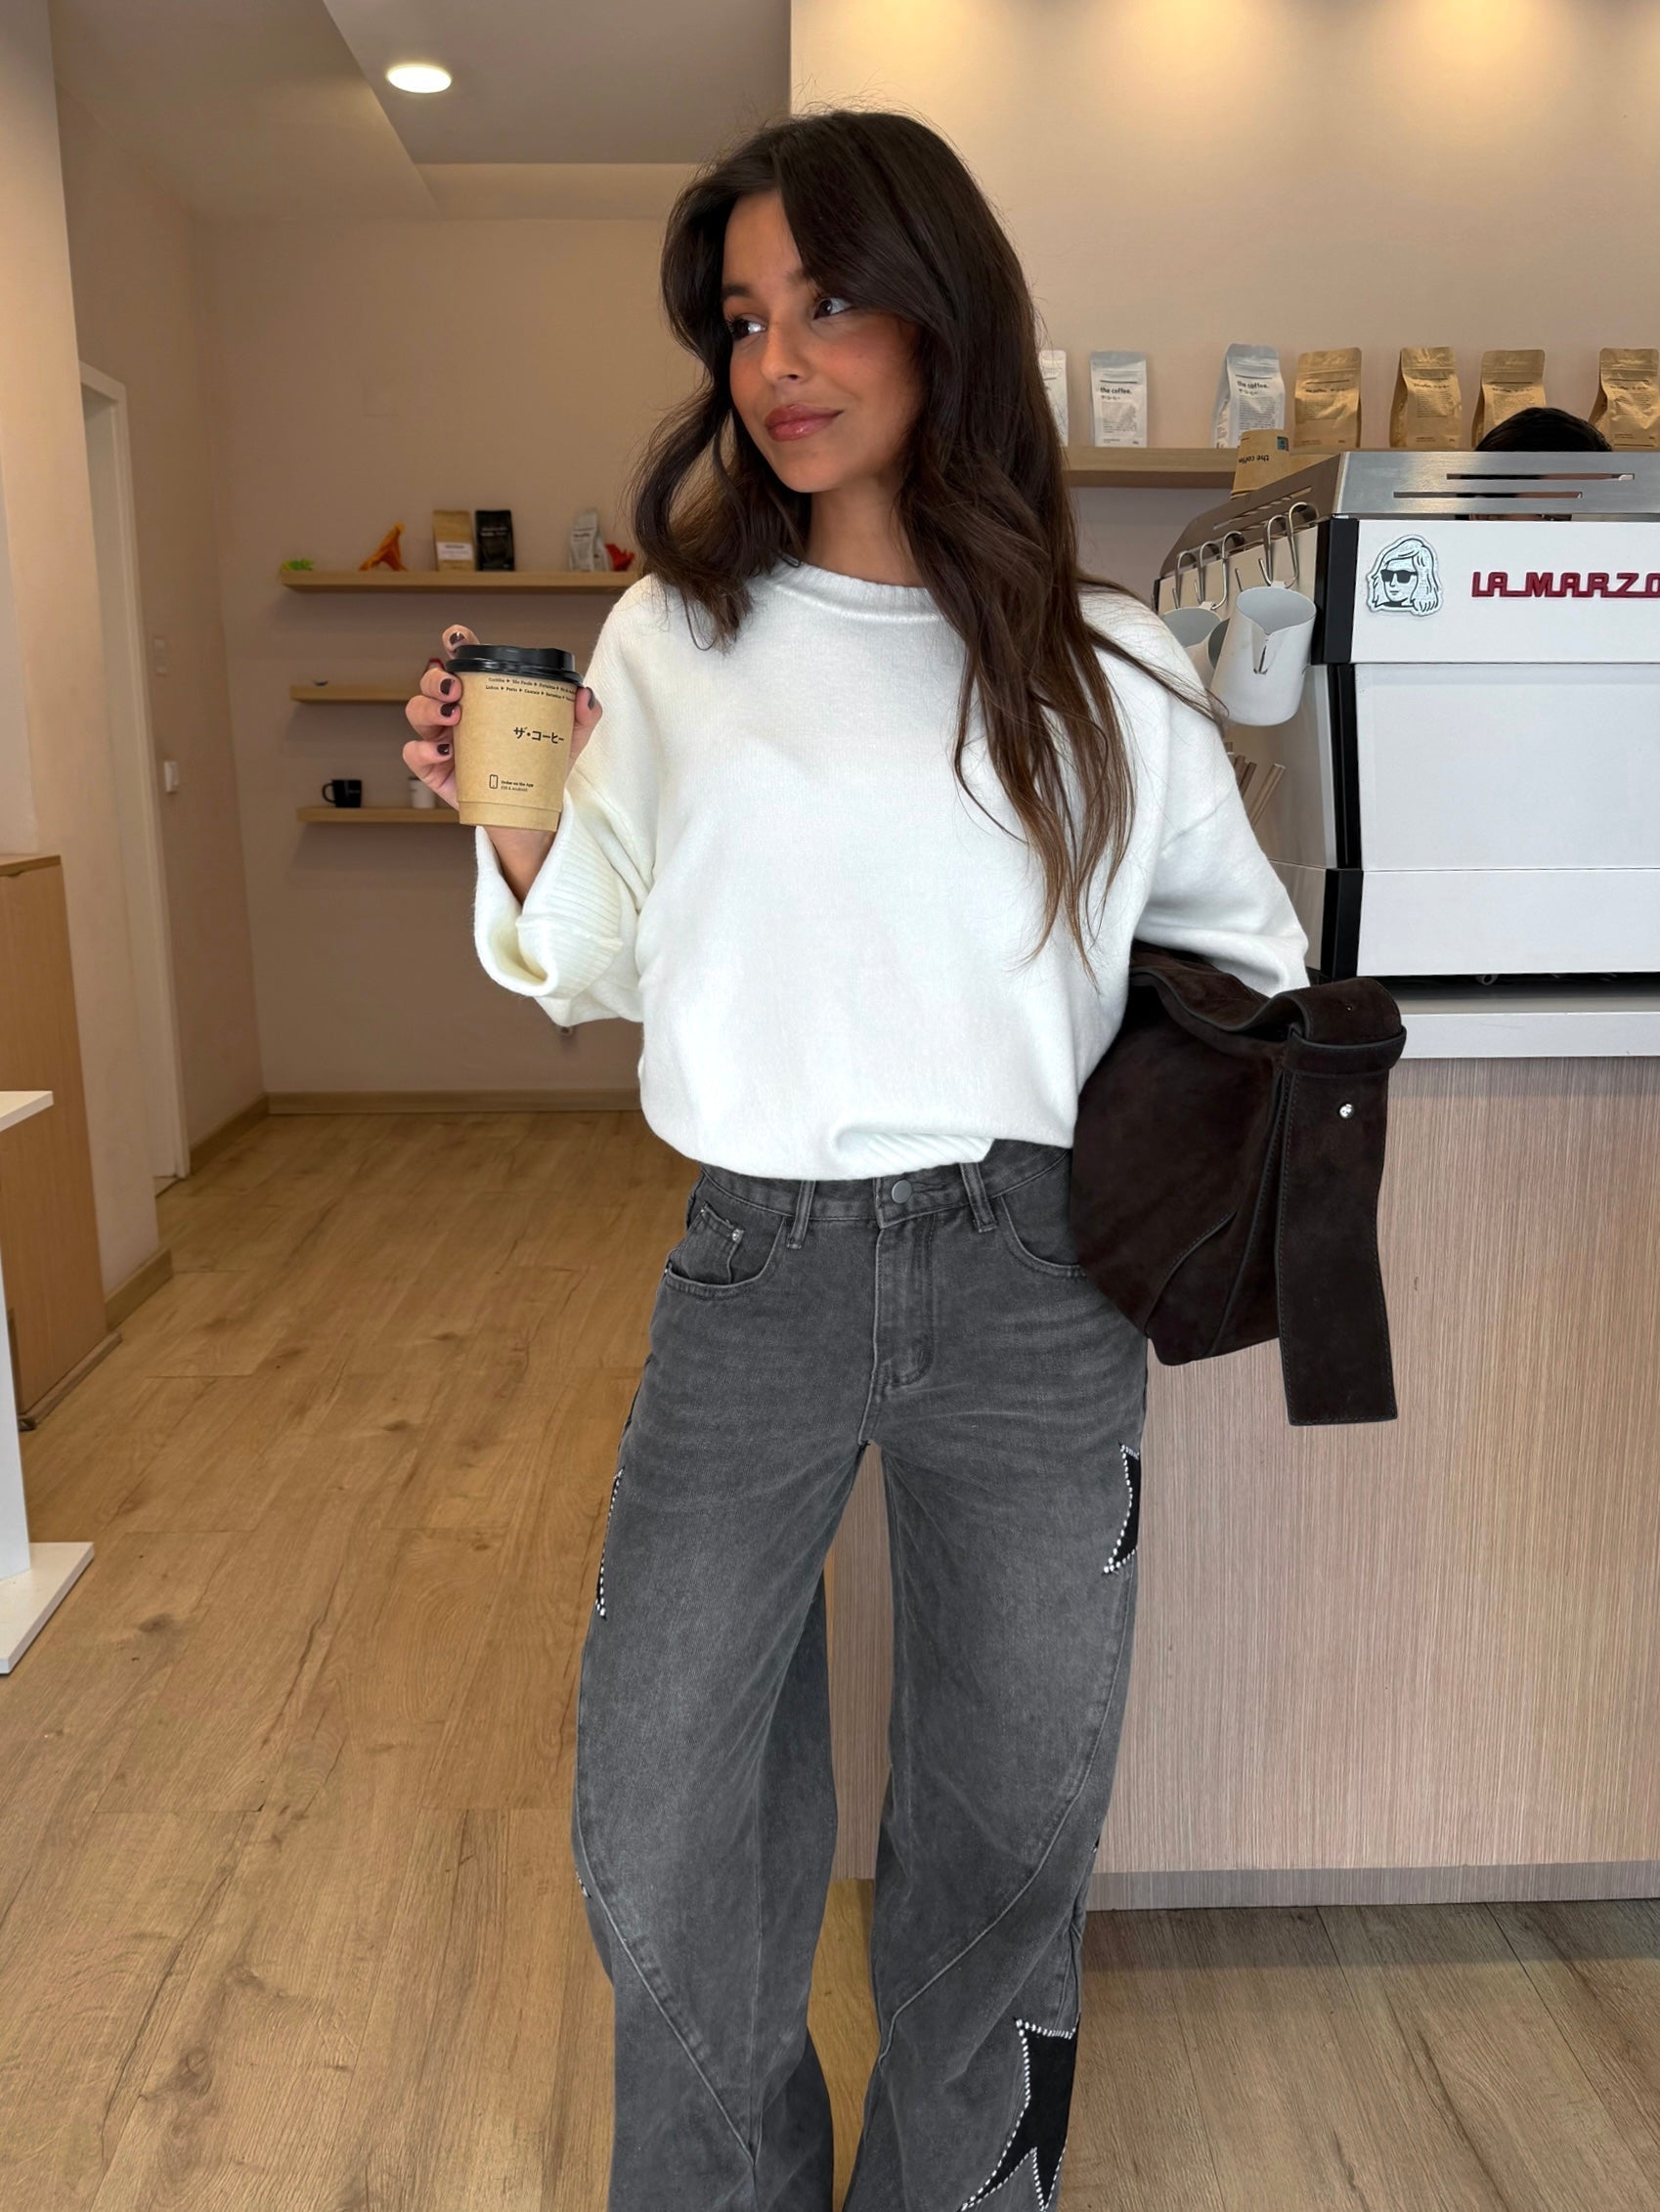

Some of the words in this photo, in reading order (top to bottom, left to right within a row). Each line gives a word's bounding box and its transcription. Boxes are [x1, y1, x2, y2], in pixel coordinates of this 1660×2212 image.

[1472, 572, 1508, 597] LA
[513, 726, 564, 744] ザ・コーヒー
